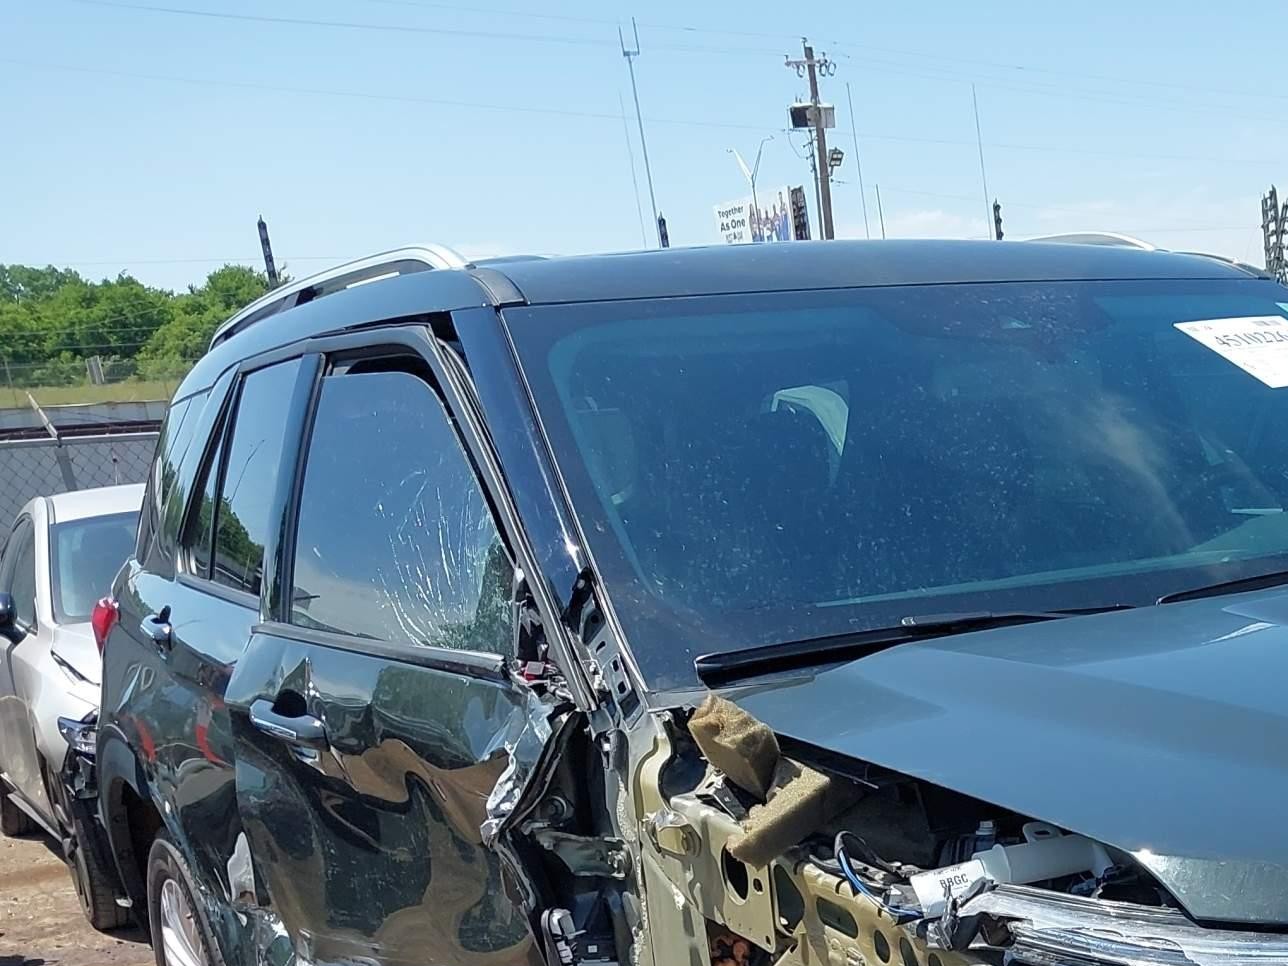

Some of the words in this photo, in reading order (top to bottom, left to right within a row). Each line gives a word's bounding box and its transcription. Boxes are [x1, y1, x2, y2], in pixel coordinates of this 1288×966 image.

[718, 207, 744, 219] Together
[720, 221, 730, 232] As
[731, 219, 746, 229] One
